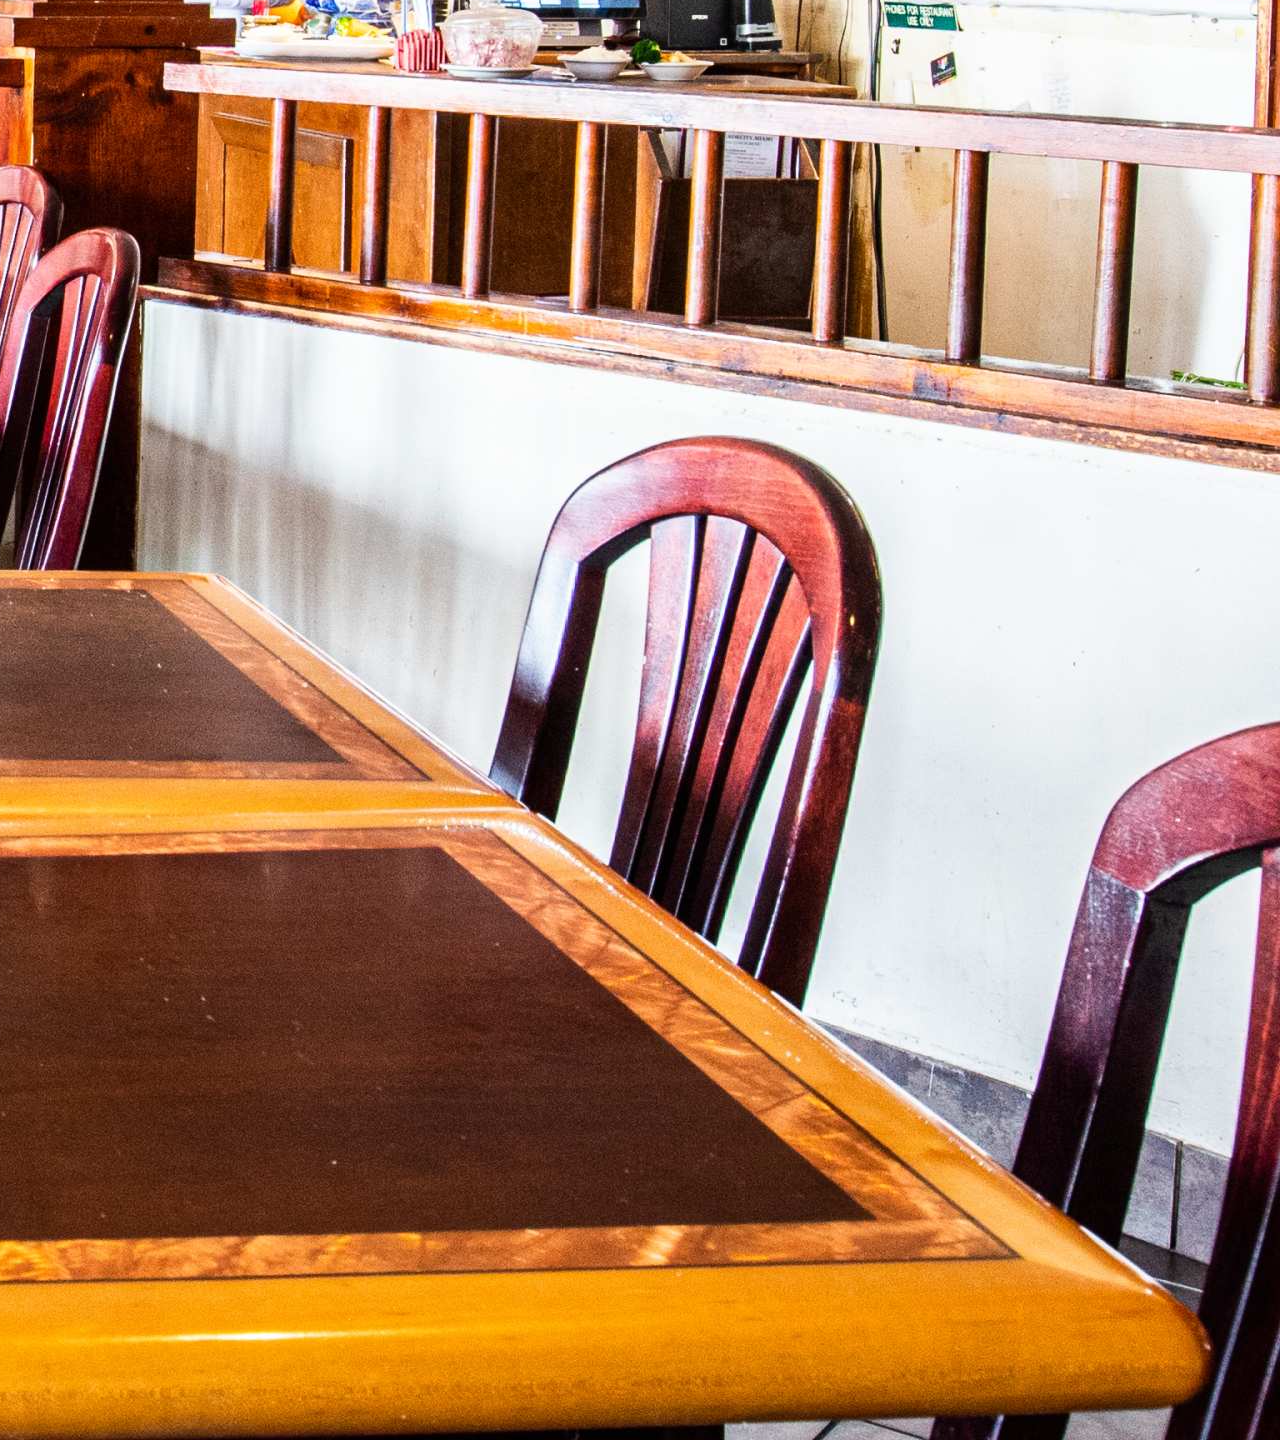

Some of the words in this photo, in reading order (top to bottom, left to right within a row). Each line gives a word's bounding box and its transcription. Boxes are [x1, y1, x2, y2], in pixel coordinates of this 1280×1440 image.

[884, 4, 906, 15] PHONES
[906, 5, 919, 16] FOR
[919, 6, 954, 18] RESTAURANT
[907, 16, 919, 26] USE
[919, 17, 934, 27] ONLY
